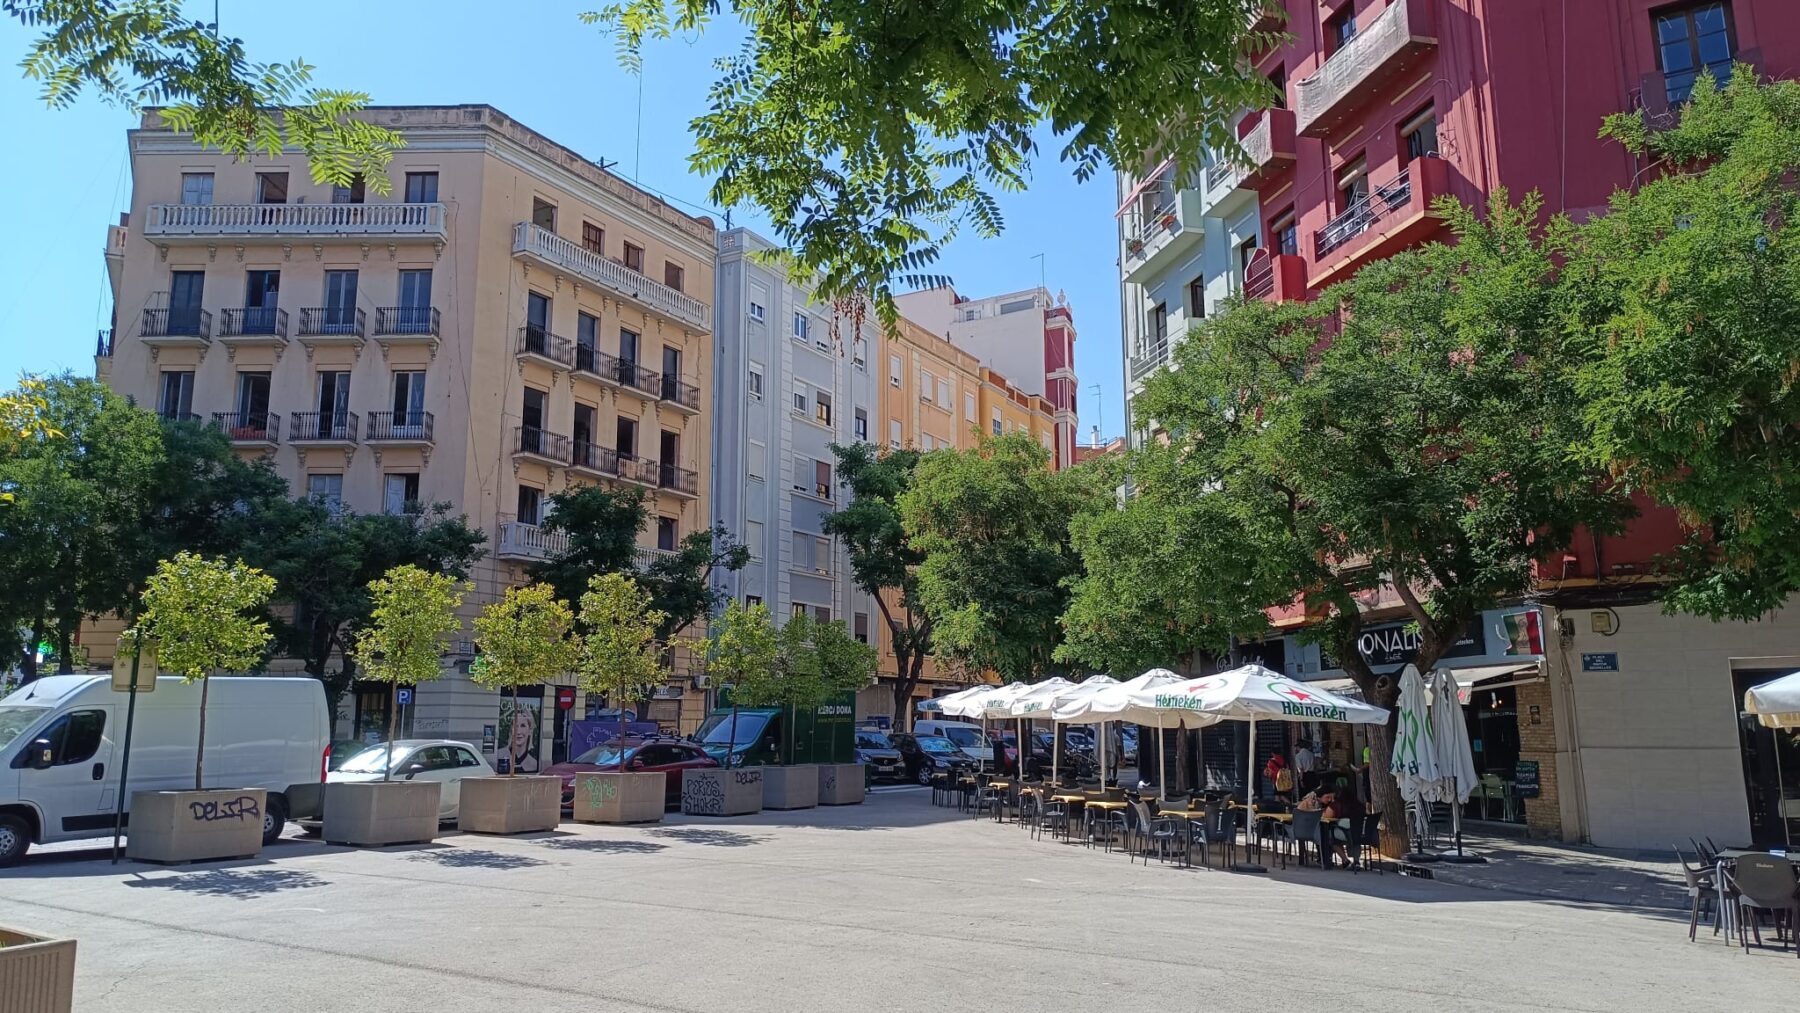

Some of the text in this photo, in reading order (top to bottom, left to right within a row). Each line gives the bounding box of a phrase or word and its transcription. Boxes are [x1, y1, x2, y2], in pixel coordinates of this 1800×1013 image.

[1358, 630, 1424, 655] ONALIS
[1155, 694, 1203, 710] Heineken
[1281, 701, 1348, 722] Heineken
